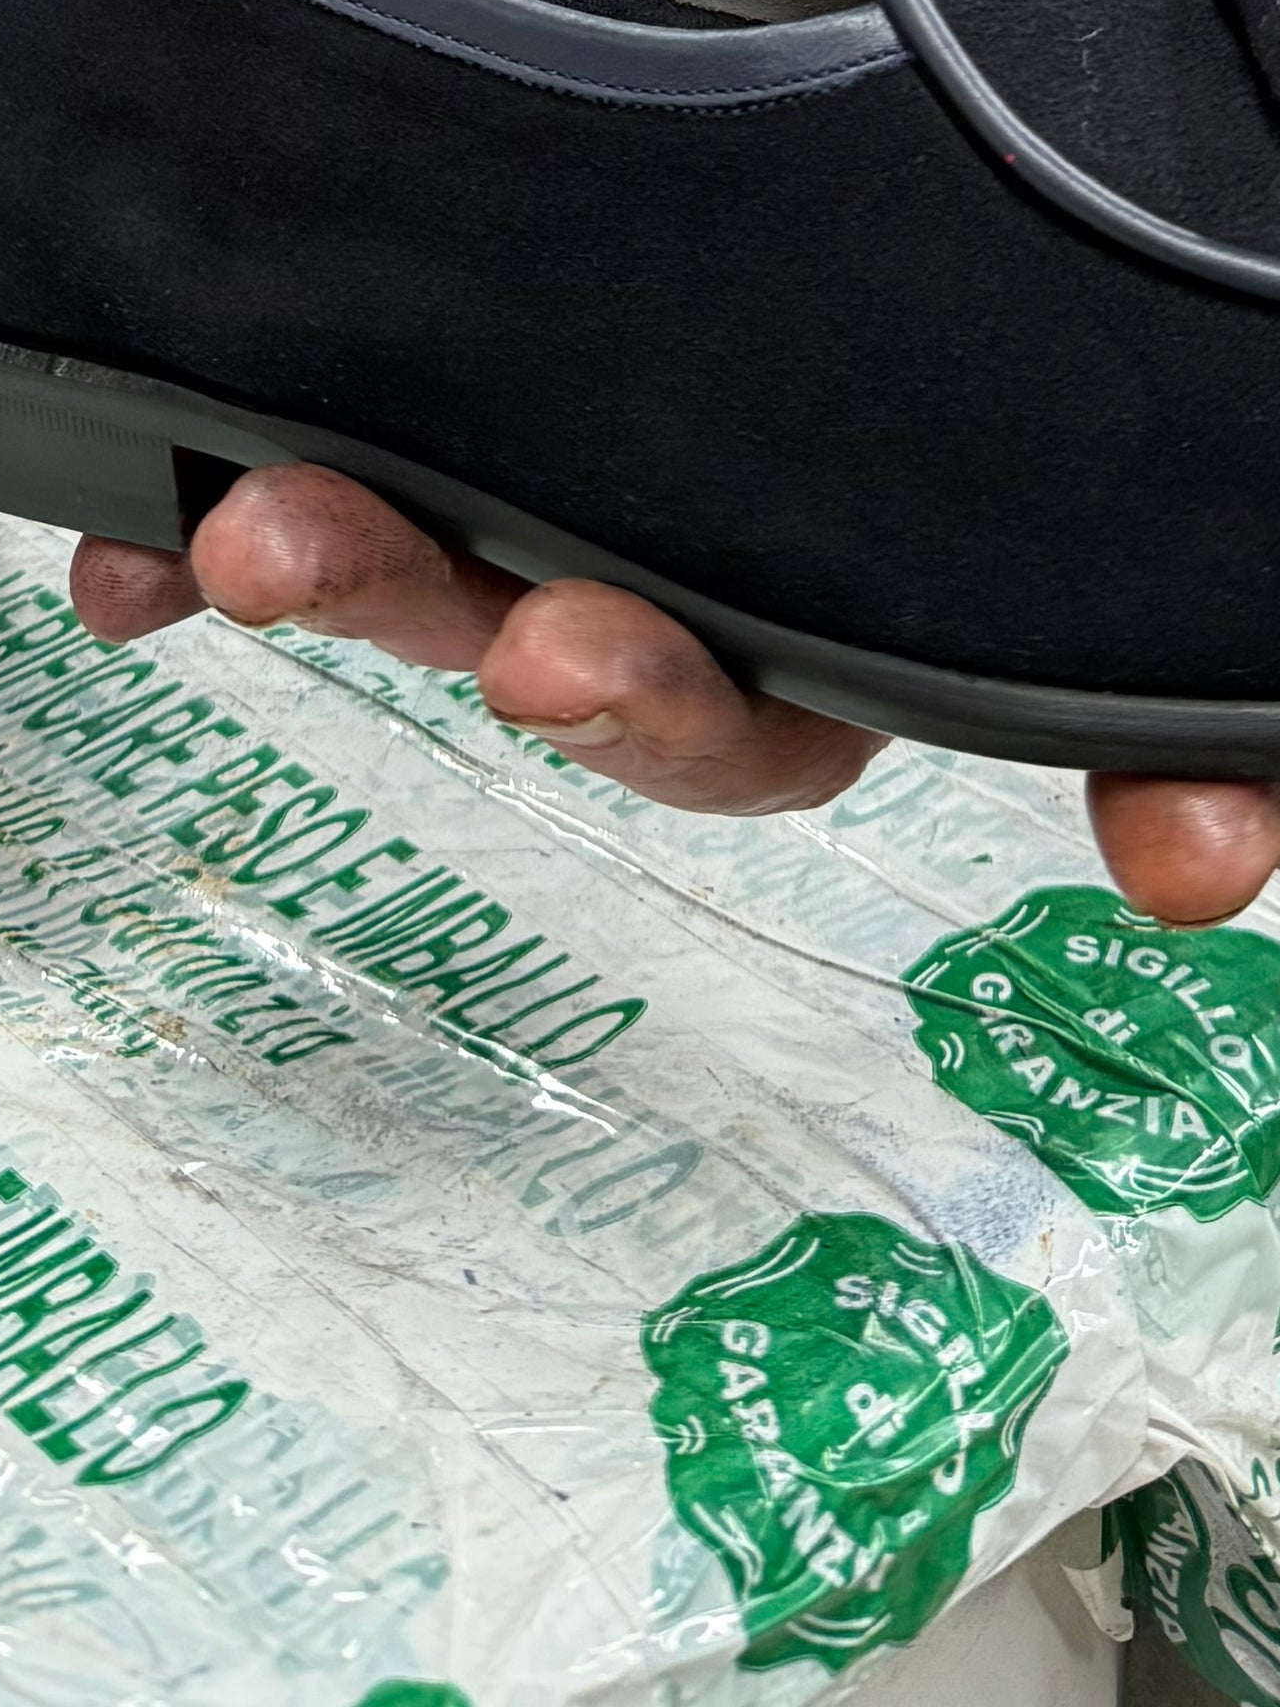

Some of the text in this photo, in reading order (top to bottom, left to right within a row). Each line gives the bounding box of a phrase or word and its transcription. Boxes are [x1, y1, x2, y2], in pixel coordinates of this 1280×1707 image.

[137, 741, 372, 884] PESO
[267, 835, 422, 920] E
[79, 867, 359, 1067] Garanzia
[310, 864, 649, 1086] IMBALLO
[1063, 934, 1259, 1071] SIGILLO
[1082, 1006, 1141, 1048] di
[970, 971, 1213, 1143] GRANZIA
[842, 1382, 907, 1449] di
